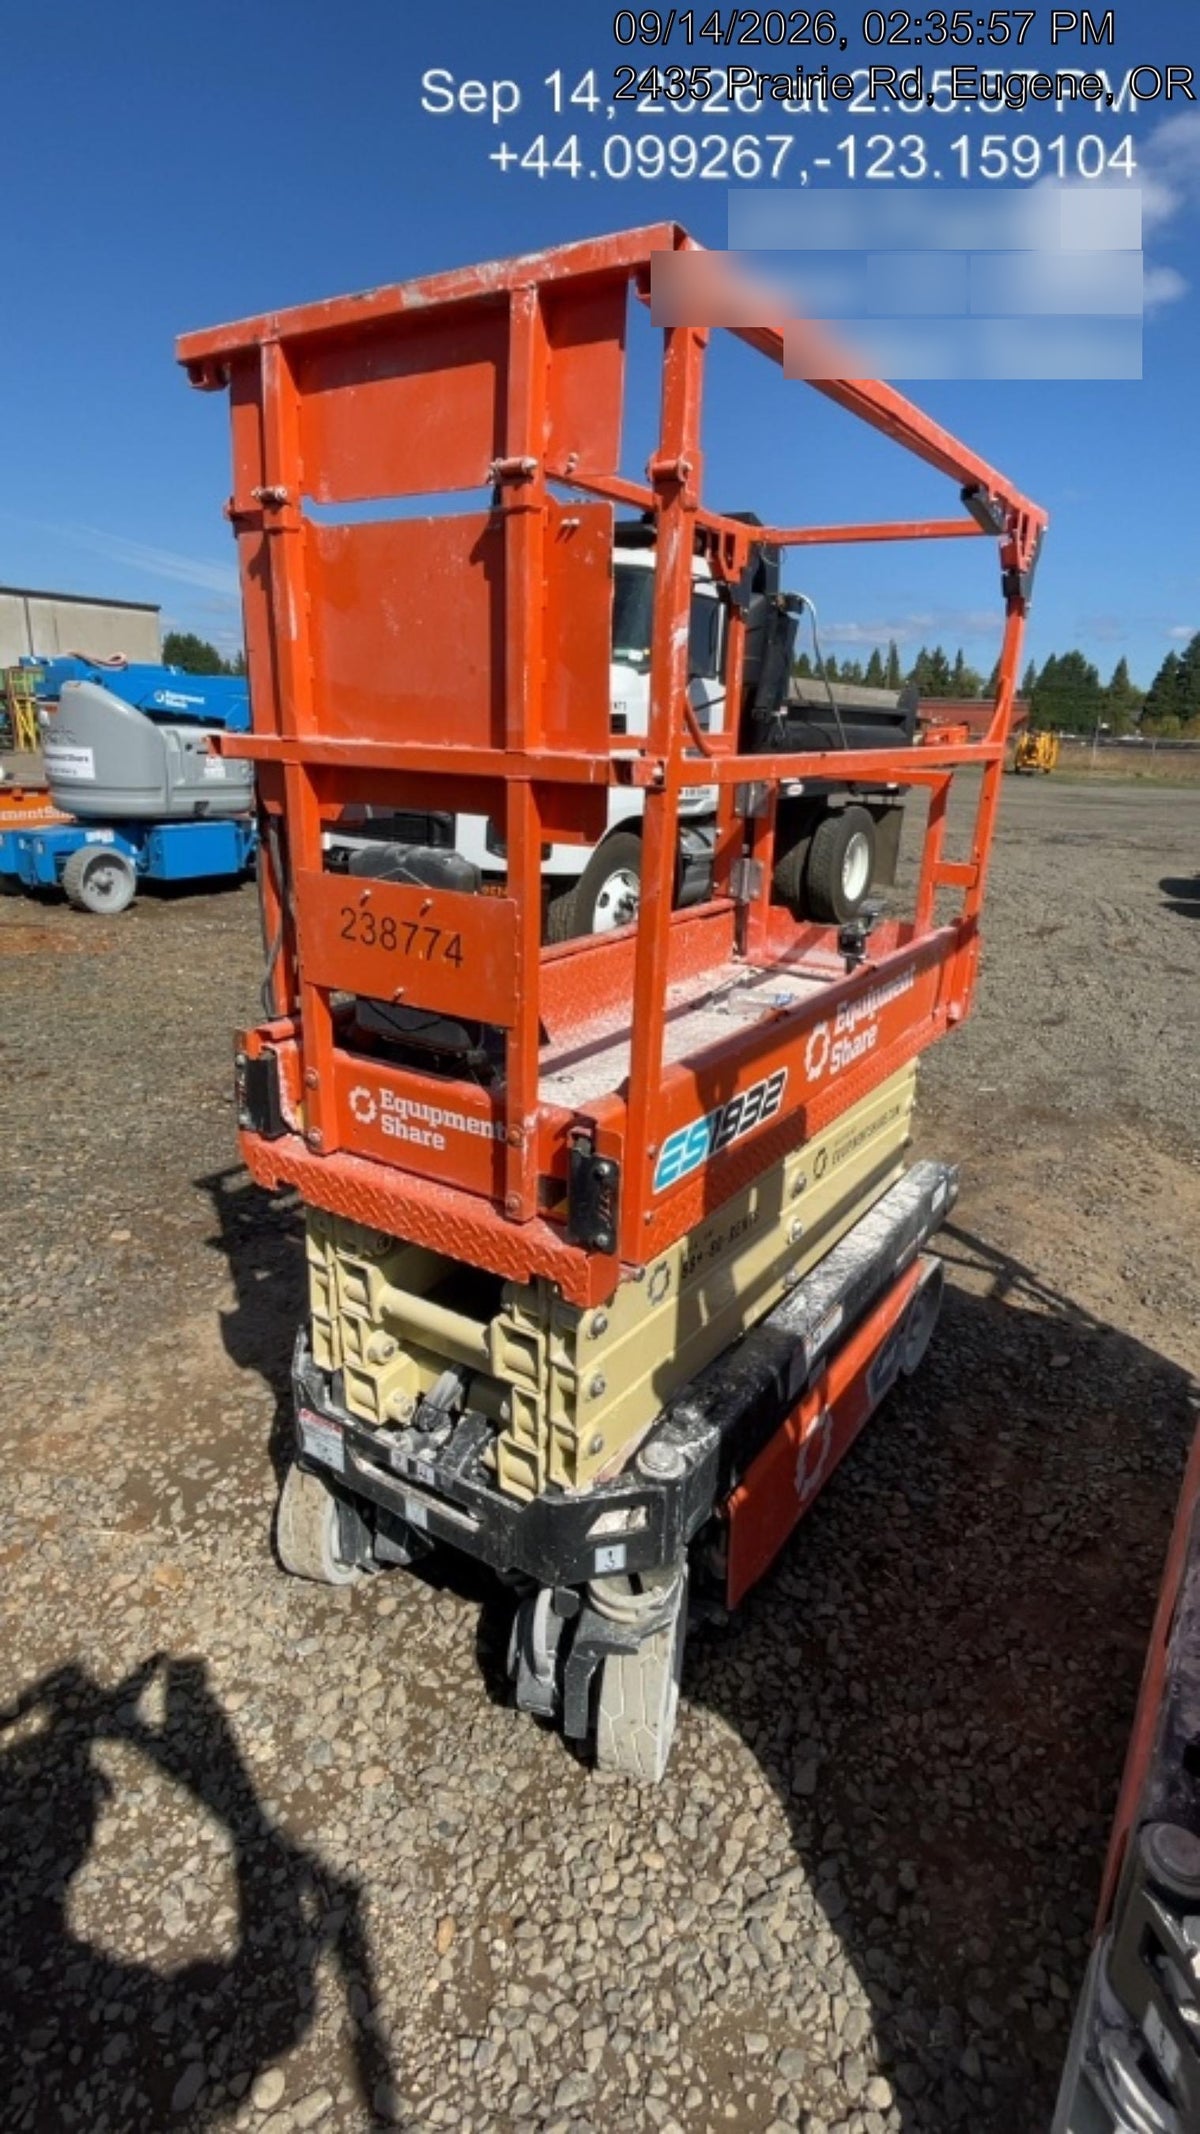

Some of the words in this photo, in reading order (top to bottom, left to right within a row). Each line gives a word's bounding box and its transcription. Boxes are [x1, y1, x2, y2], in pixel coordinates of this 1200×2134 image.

[340, 907, 463, 968] 238774
[835, 963, 916, 1036] Equipment
[830, 1025, 878, 1075] Share
[379, 1088, 508, 1142] Equipment
[381, 1114, 446, 1150] Share
[655, 1069, 786, 1190] ES1932
